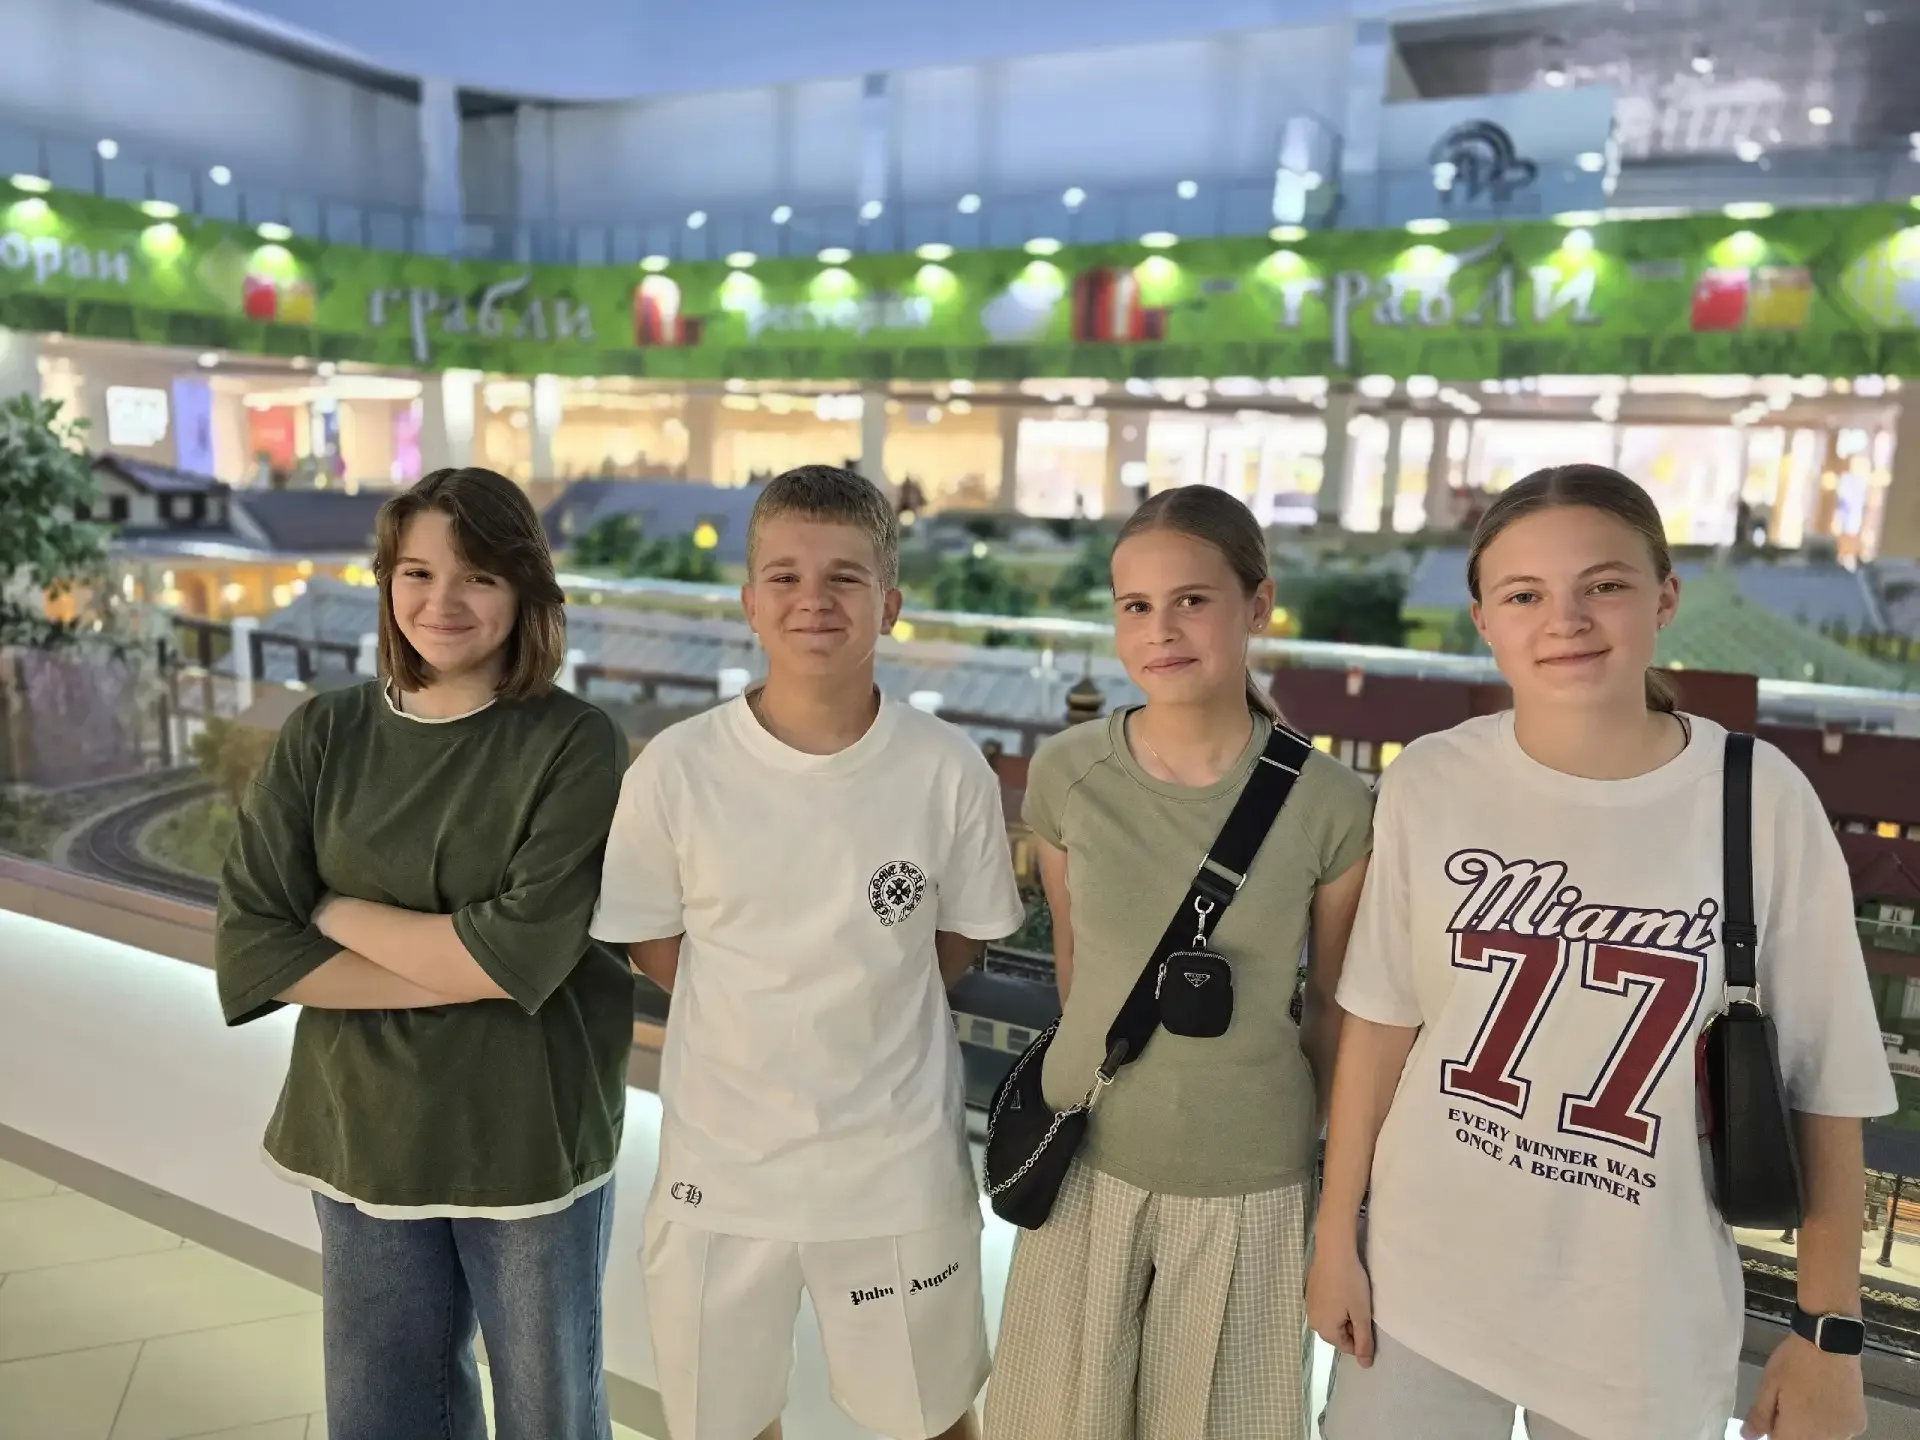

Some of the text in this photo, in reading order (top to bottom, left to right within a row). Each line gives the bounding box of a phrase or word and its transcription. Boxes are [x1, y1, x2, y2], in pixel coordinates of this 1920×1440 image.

[1444, 848, 1719, 952] Miami
[1440, 932, 1708, 1159] 77
[1448, 1107, 1657, 1189] EVERY WINNER WAS
[1455, 1127, 1641, 1206] ONCE A BEGINNER
[849, 1261, 960, 1306] Palm Angels
